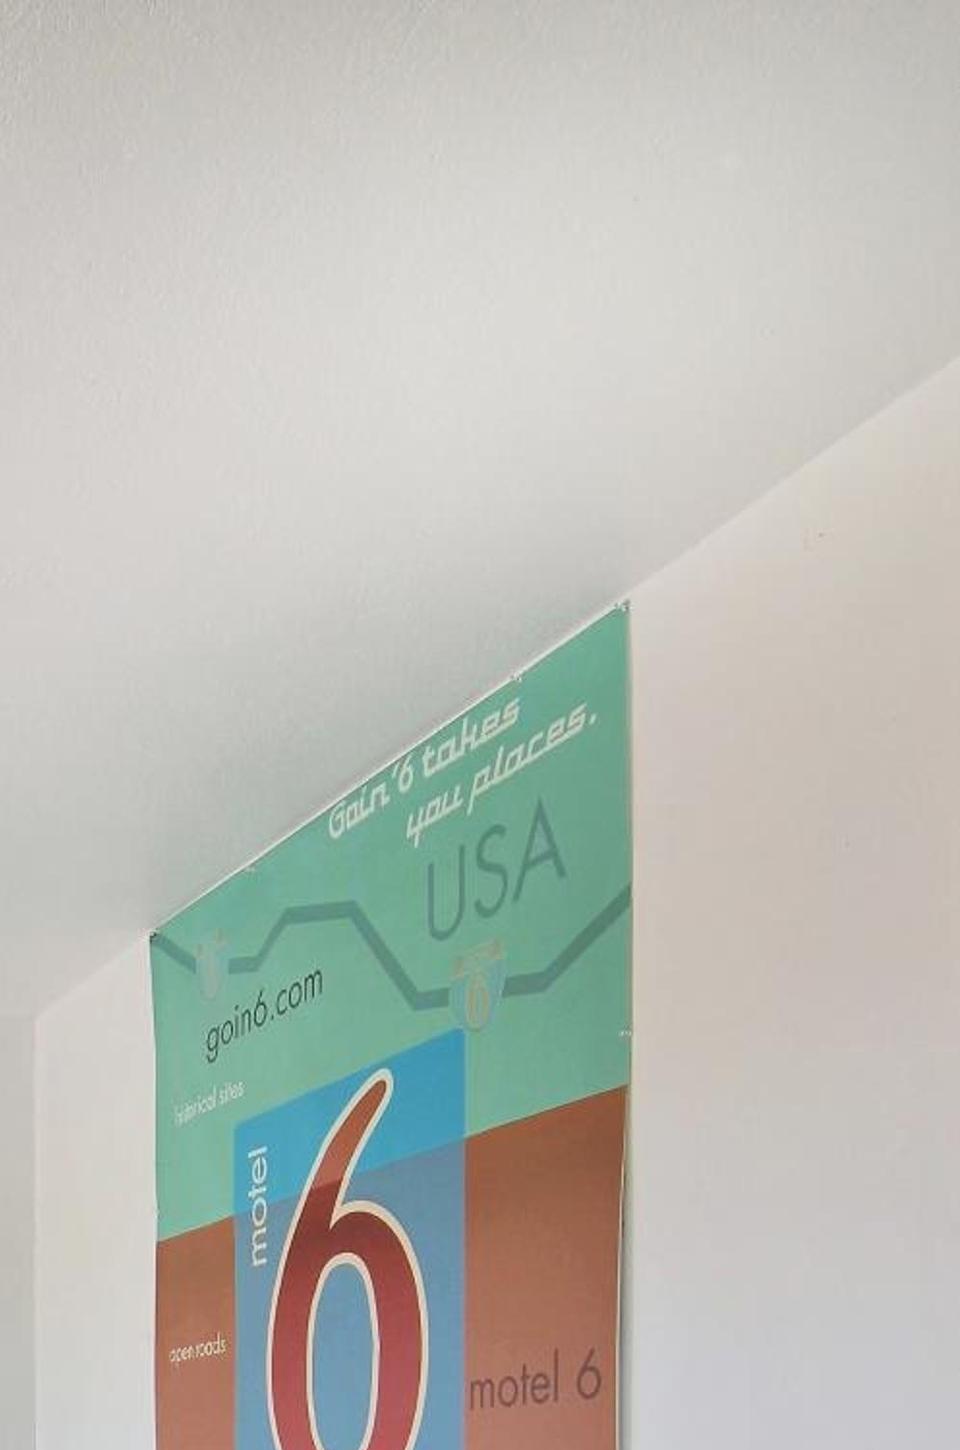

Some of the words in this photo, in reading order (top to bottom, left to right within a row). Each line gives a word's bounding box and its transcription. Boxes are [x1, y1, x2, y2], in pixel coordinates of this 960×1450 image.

[406, 791, 463, 848] you
[467, 703, 597, 816] places.
[423, 698, 520, 778] takes
[427, 796, 567, 941] USA
[205, 966, 324, 1063] goin6.com
[248, 1146, 268, 1267] motel
[469, 1349, 559, 1411] motel
[577, 1347, 602, 1400] 6
